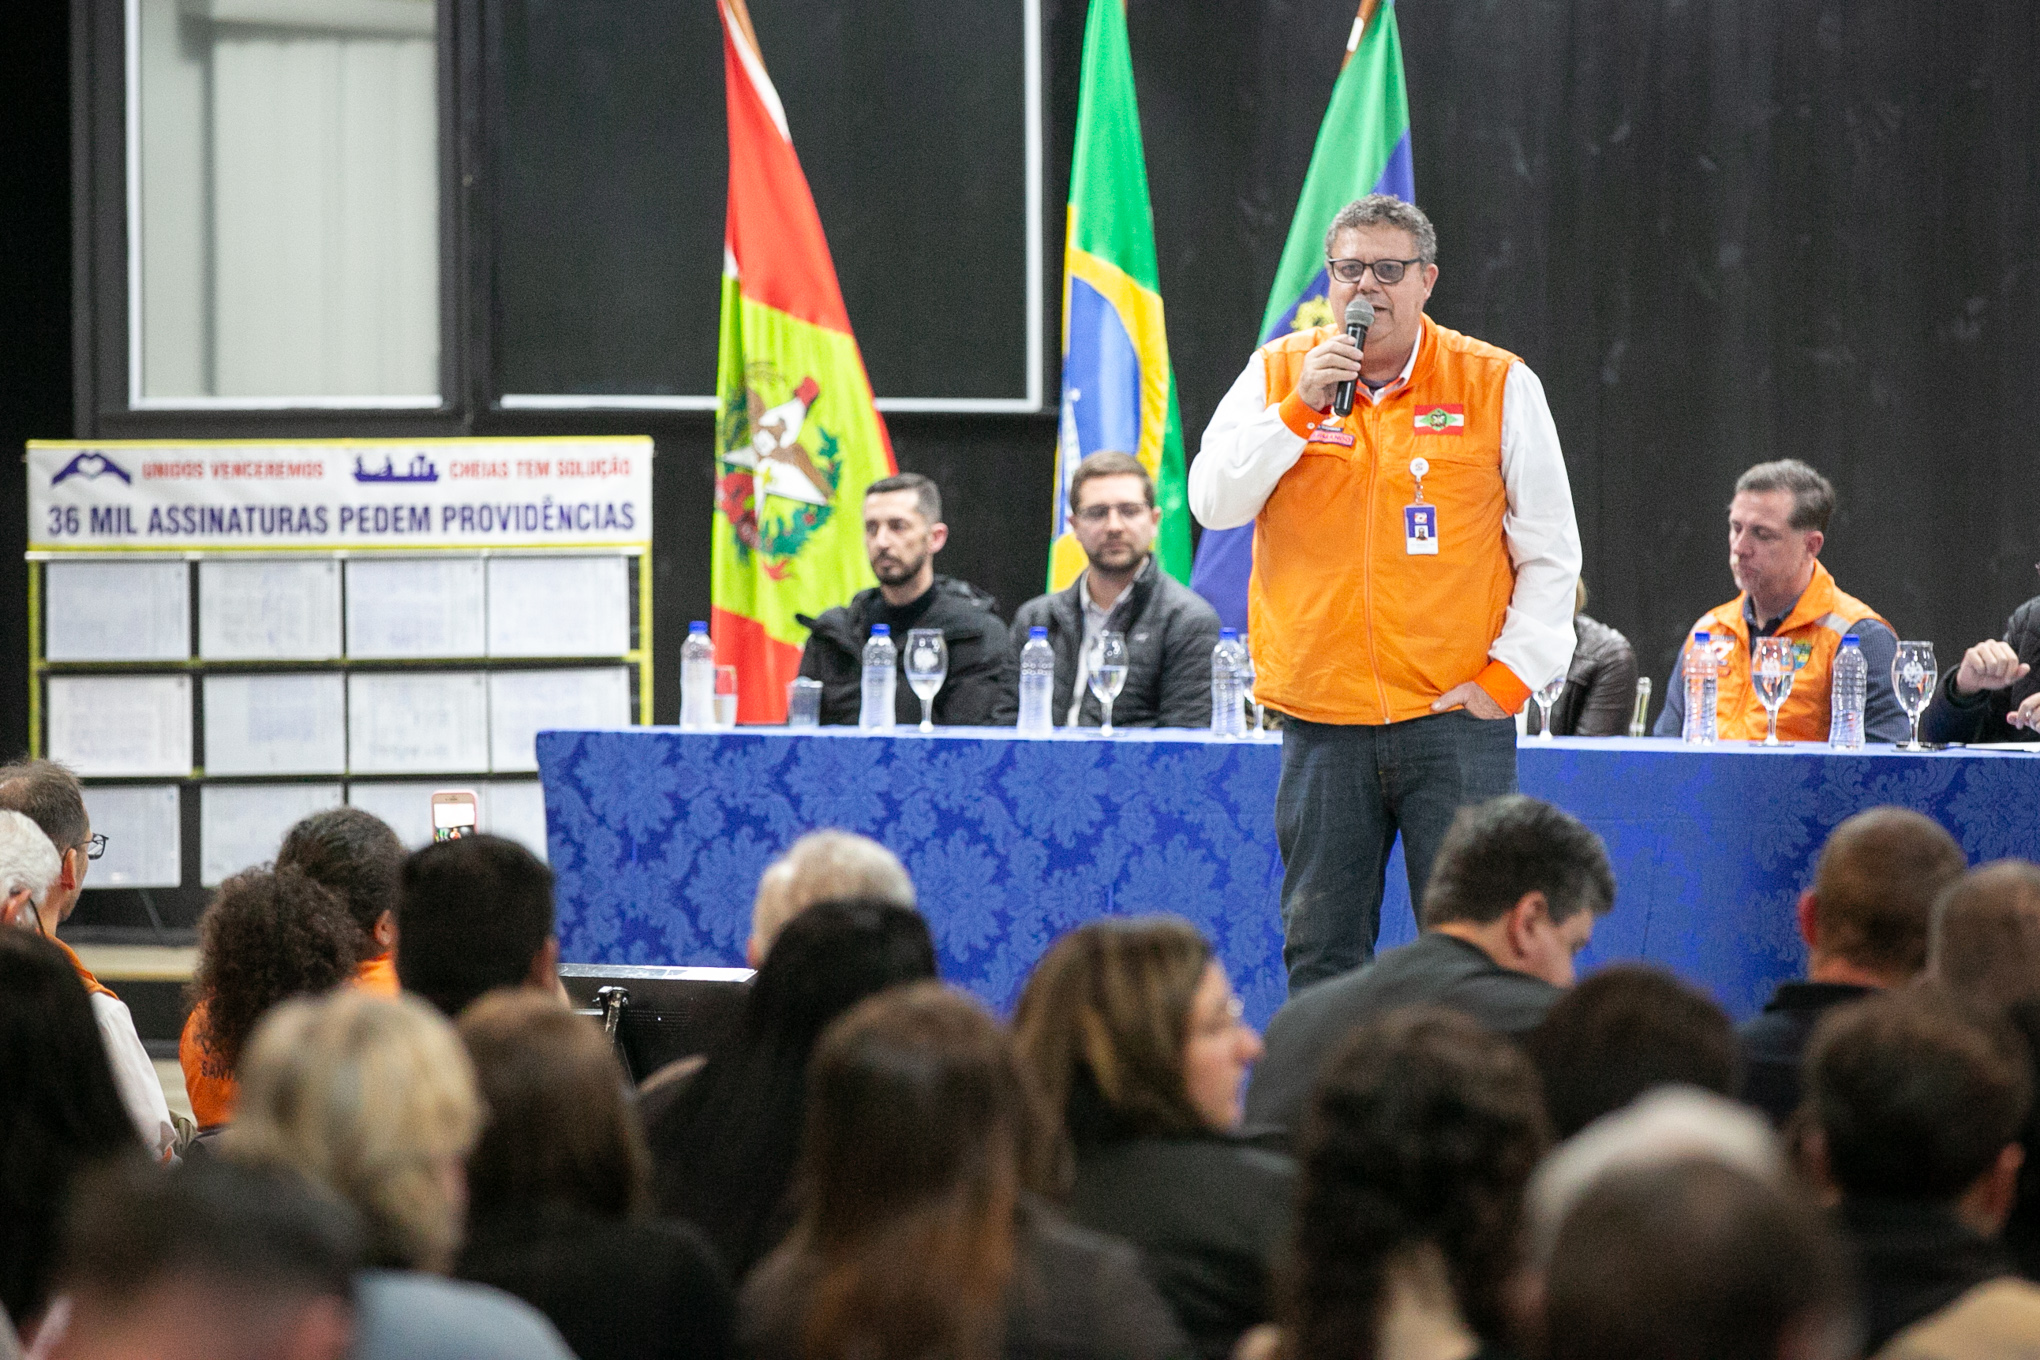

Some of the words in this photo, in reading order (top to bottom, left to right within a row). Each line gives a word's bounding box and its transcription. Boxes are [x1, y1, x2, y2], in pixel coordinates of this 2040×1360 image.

[141, 460, 204, 481] UNIDOS
[210, 460, 323, 479] VENCEREMOS
[450, 460, 509, 479] CHEIAS
[516, 460, 550, 478] TEM
[557, 457, 631, 479] SOLUÇÃO
[48, 504, 80, 537] 36
[89, 504, 138, 536] MIL
[147, 504, 329, 536] ASSINATURAS
[339, 505, 431, 534] PEDEM
[442, 495, 635, 532] PROVIDÊNCIAS
